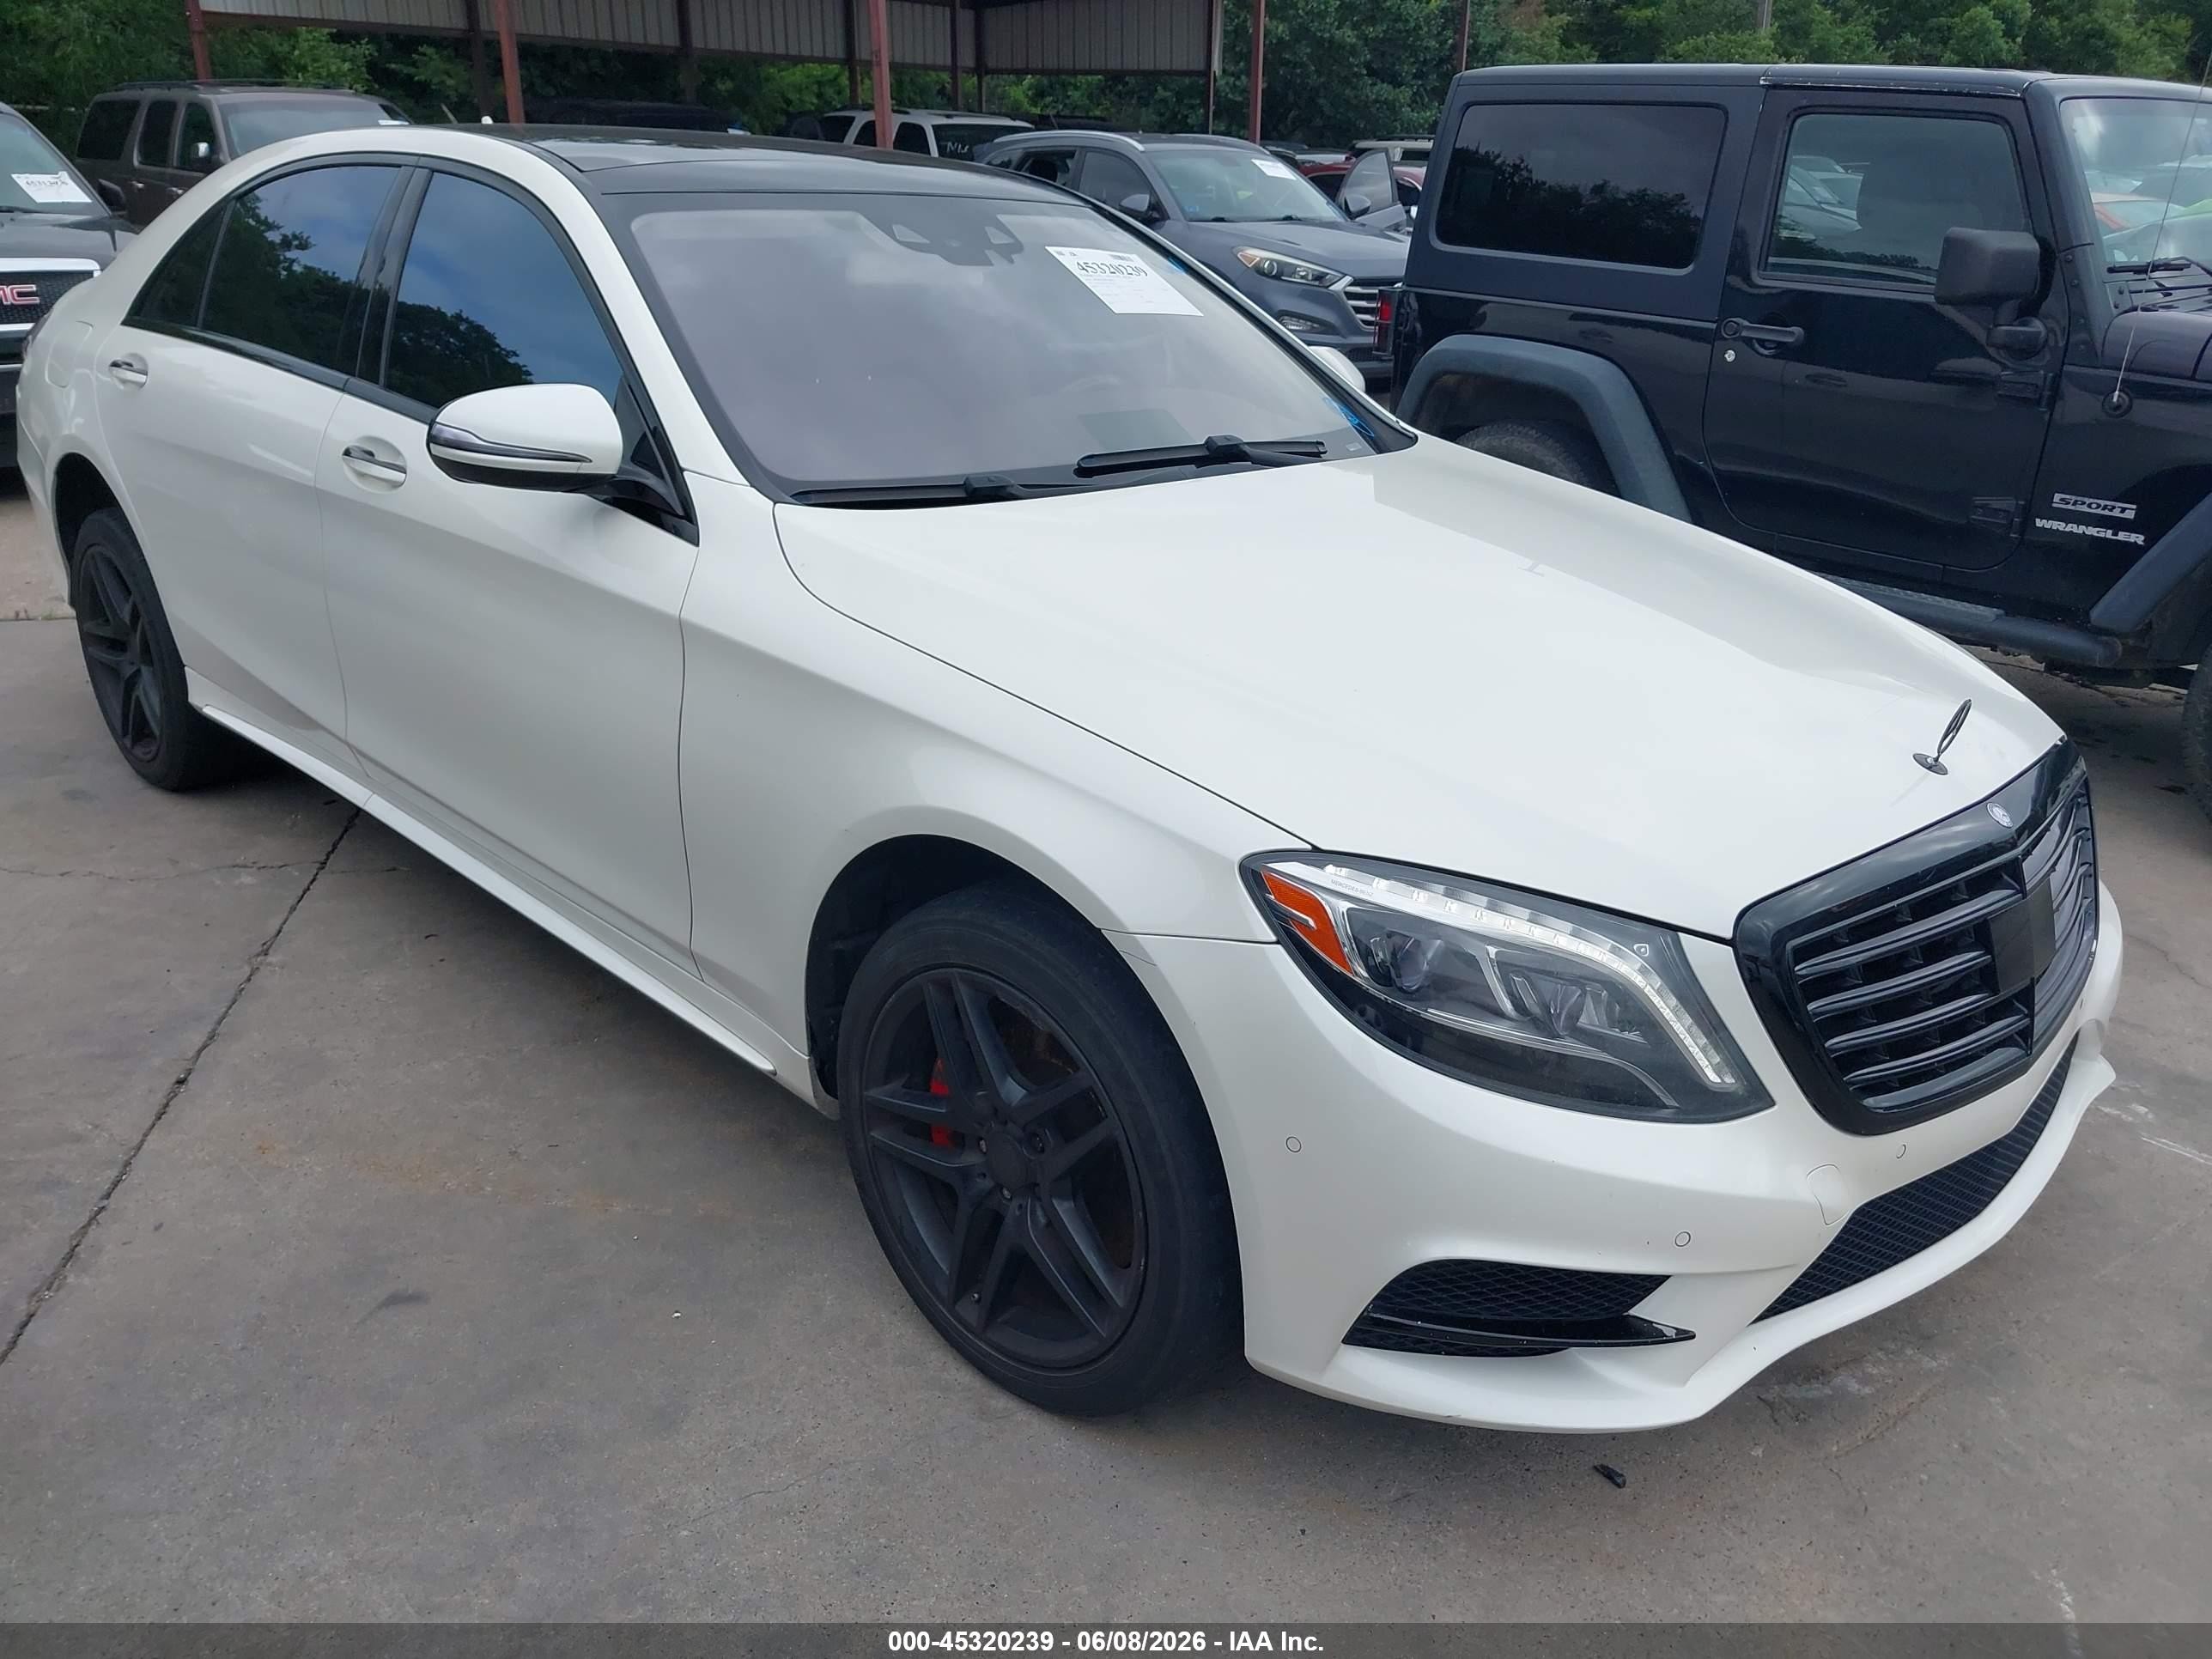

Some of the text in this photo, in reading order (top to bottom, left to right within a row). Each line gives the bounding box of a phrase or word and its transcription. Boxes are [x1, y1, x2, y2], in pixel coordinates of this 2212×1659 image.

[1077, 261, 1148, 276] 45320239
[2053, 496, 2136, 515] SPORT
[2035, 518, 2145, 545] WRANGLER
